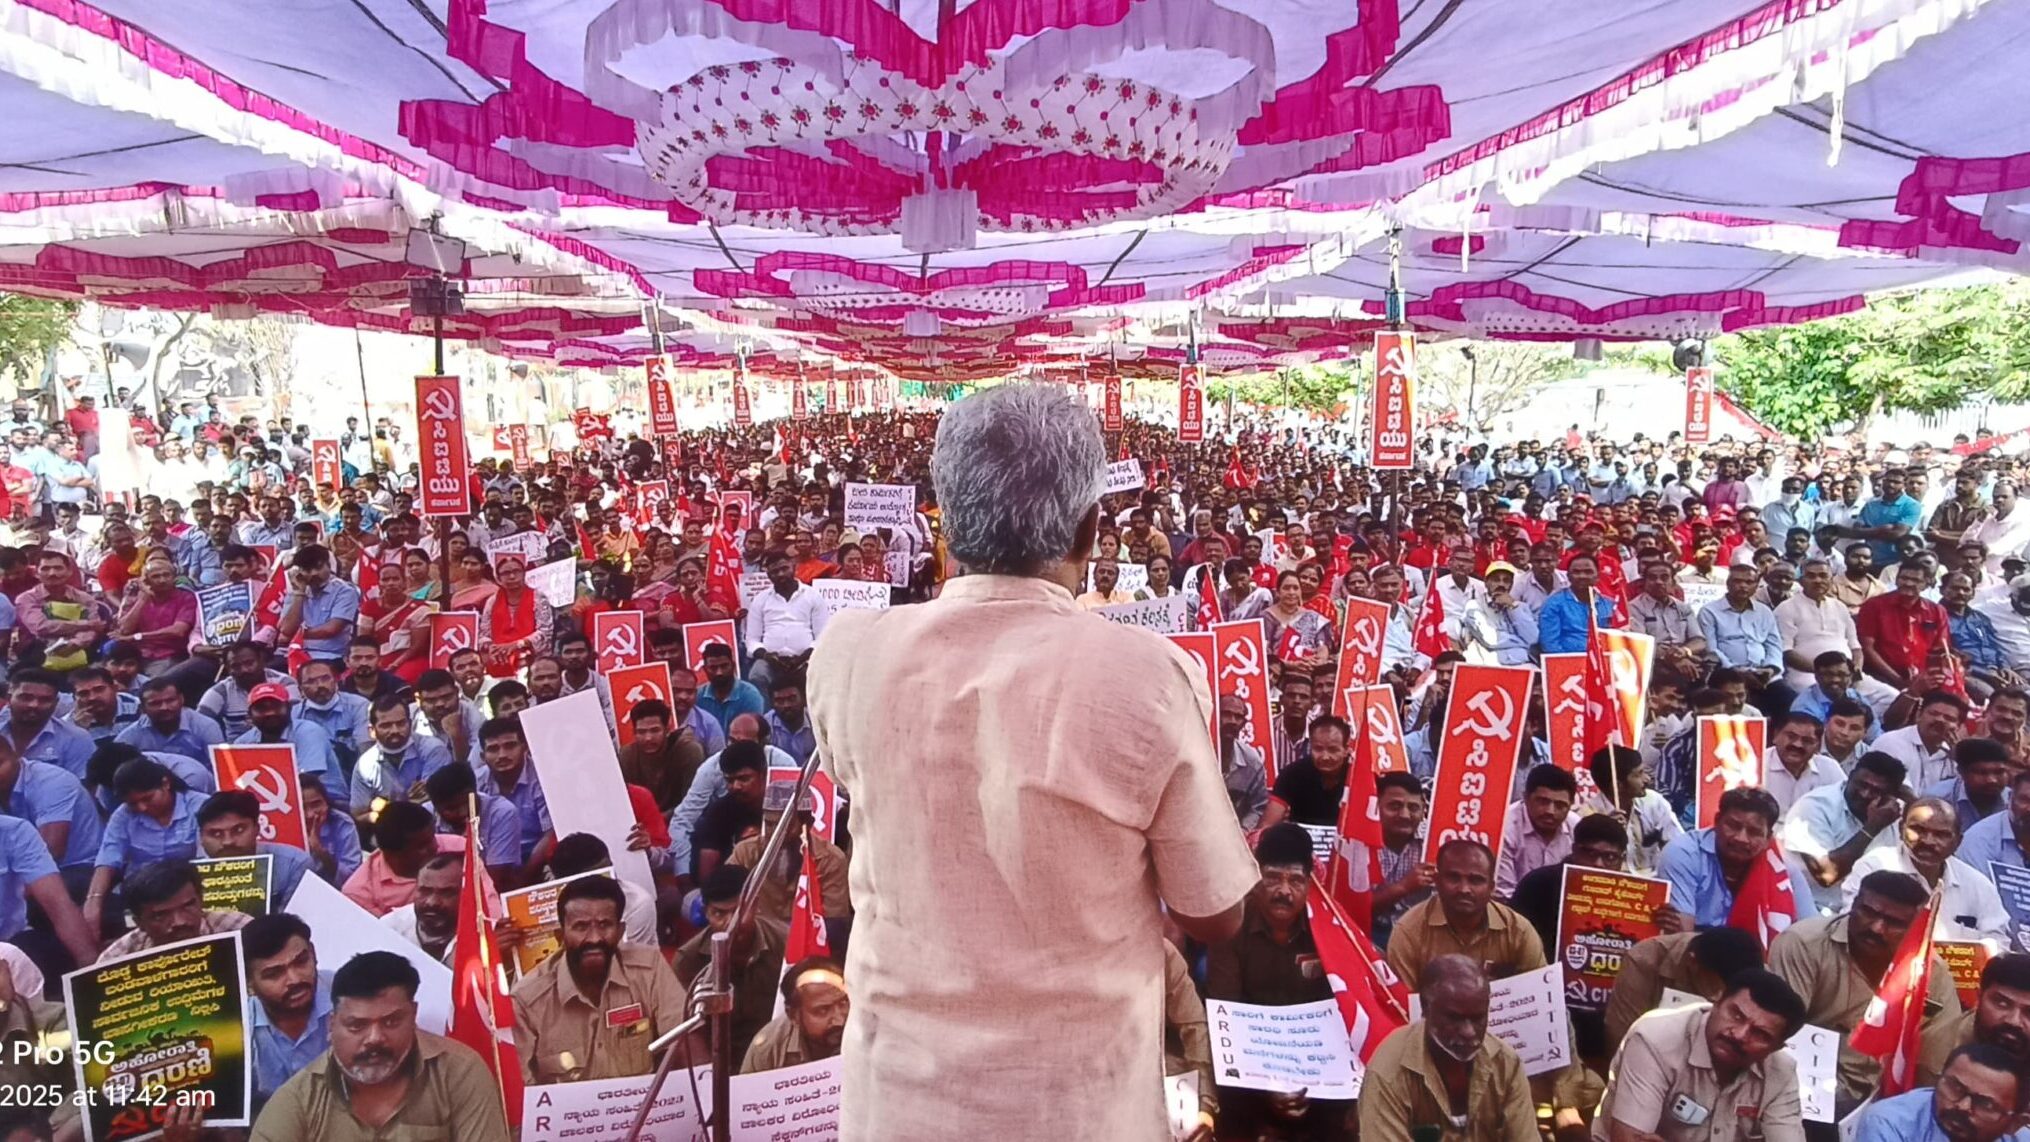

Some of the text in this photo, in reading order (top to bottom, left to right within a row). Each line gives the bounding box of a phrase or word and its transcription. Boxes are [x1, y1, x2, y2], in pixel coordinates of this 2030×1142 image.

[1380, 376, 1407, 448] ಸಿಐಟಿಯು
[428, 421, 460, 493] ಸಿಐಟಿಯು
[1216, 1004, 1235, 1065] ARDU
[774, 1070, 832, 1090] ಭಾರತೀಯ
[564, 1108, 600, 1123] ನ್ಯಾಯ
[742, 1098, 779, 1115] ನ್ಯಾಯ
[741, 1114, 785, 1129] ಚಾಲಕರ
[559, 1124, 605, 1138] ಚಾಲಕರ
